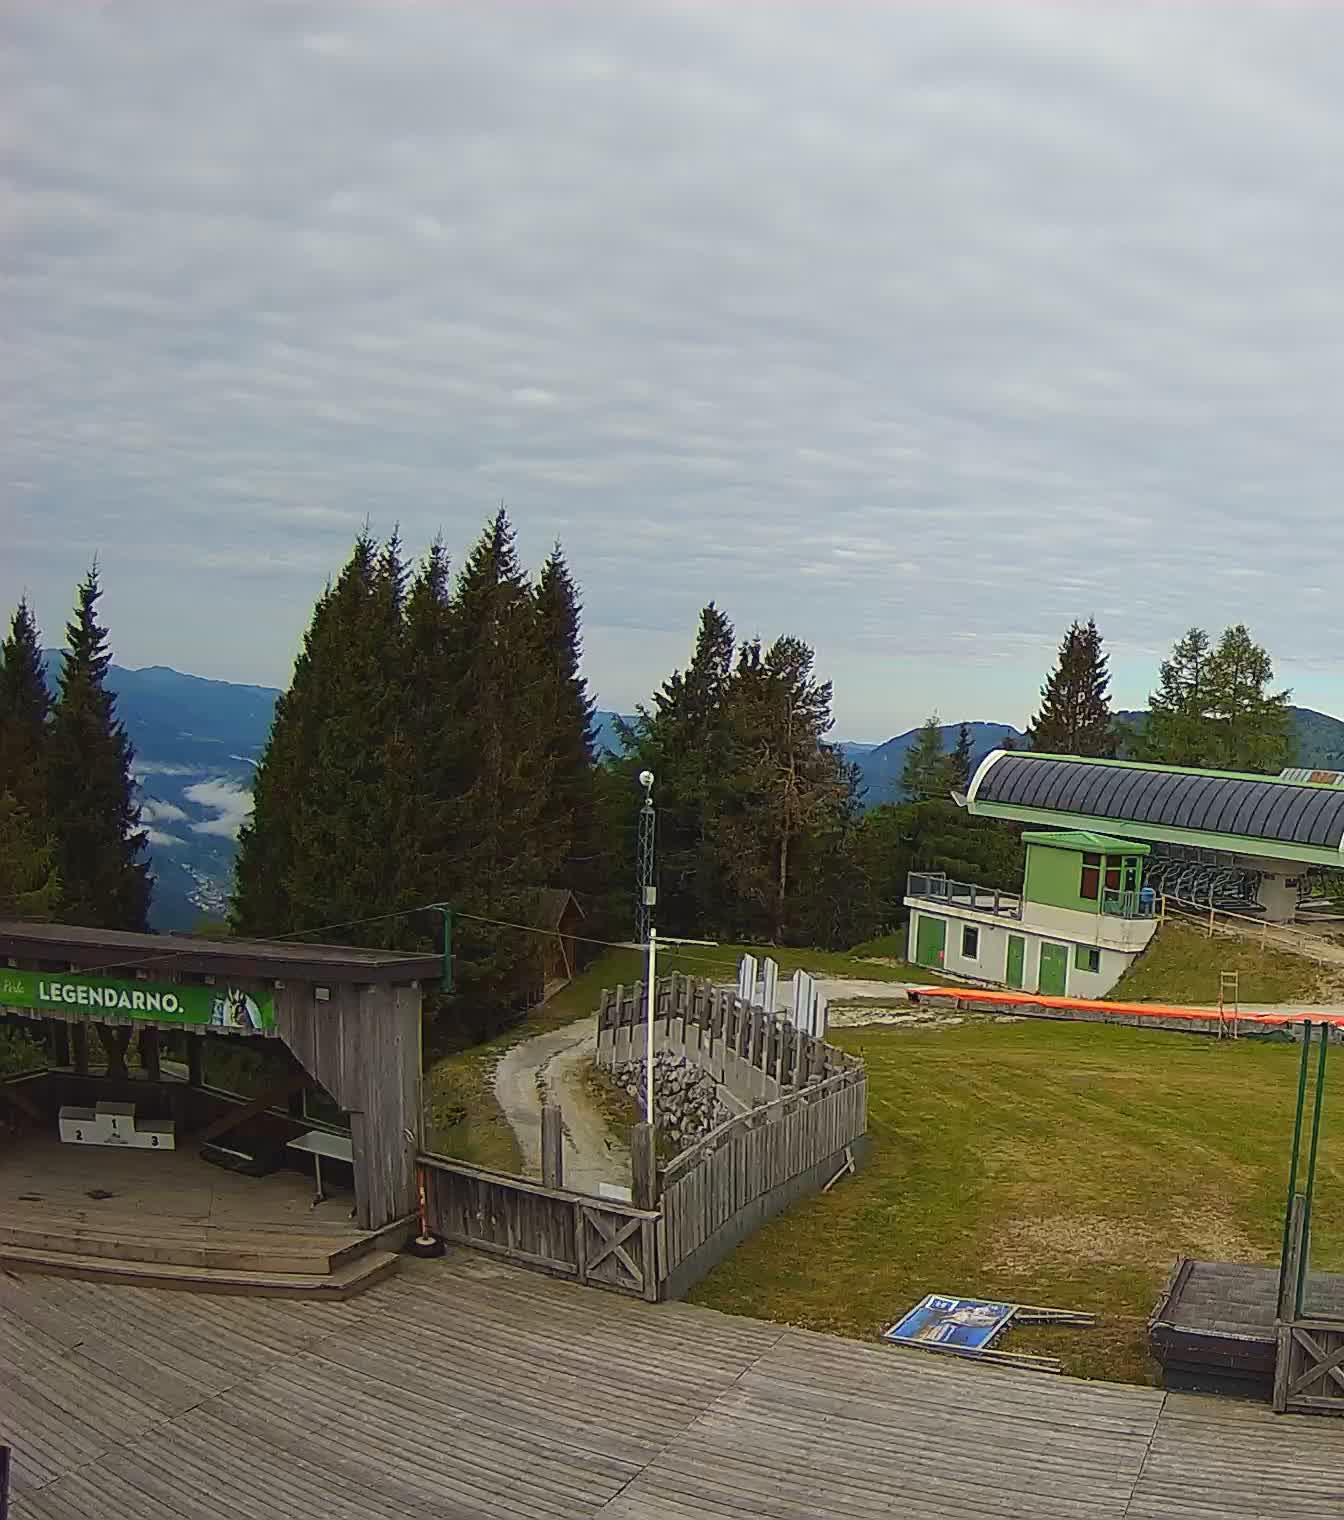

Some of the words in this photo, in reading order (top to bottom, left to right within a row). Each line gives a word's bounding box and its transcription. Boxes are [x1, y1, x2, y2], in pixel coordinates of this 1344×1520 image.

[39, 981, 185, 1014] LEGENDARNO.
[111, 1119, 118, 1129] 1
[75, 1129, 83, 1141] 2
[151, 1136, 159, 1147] 3
